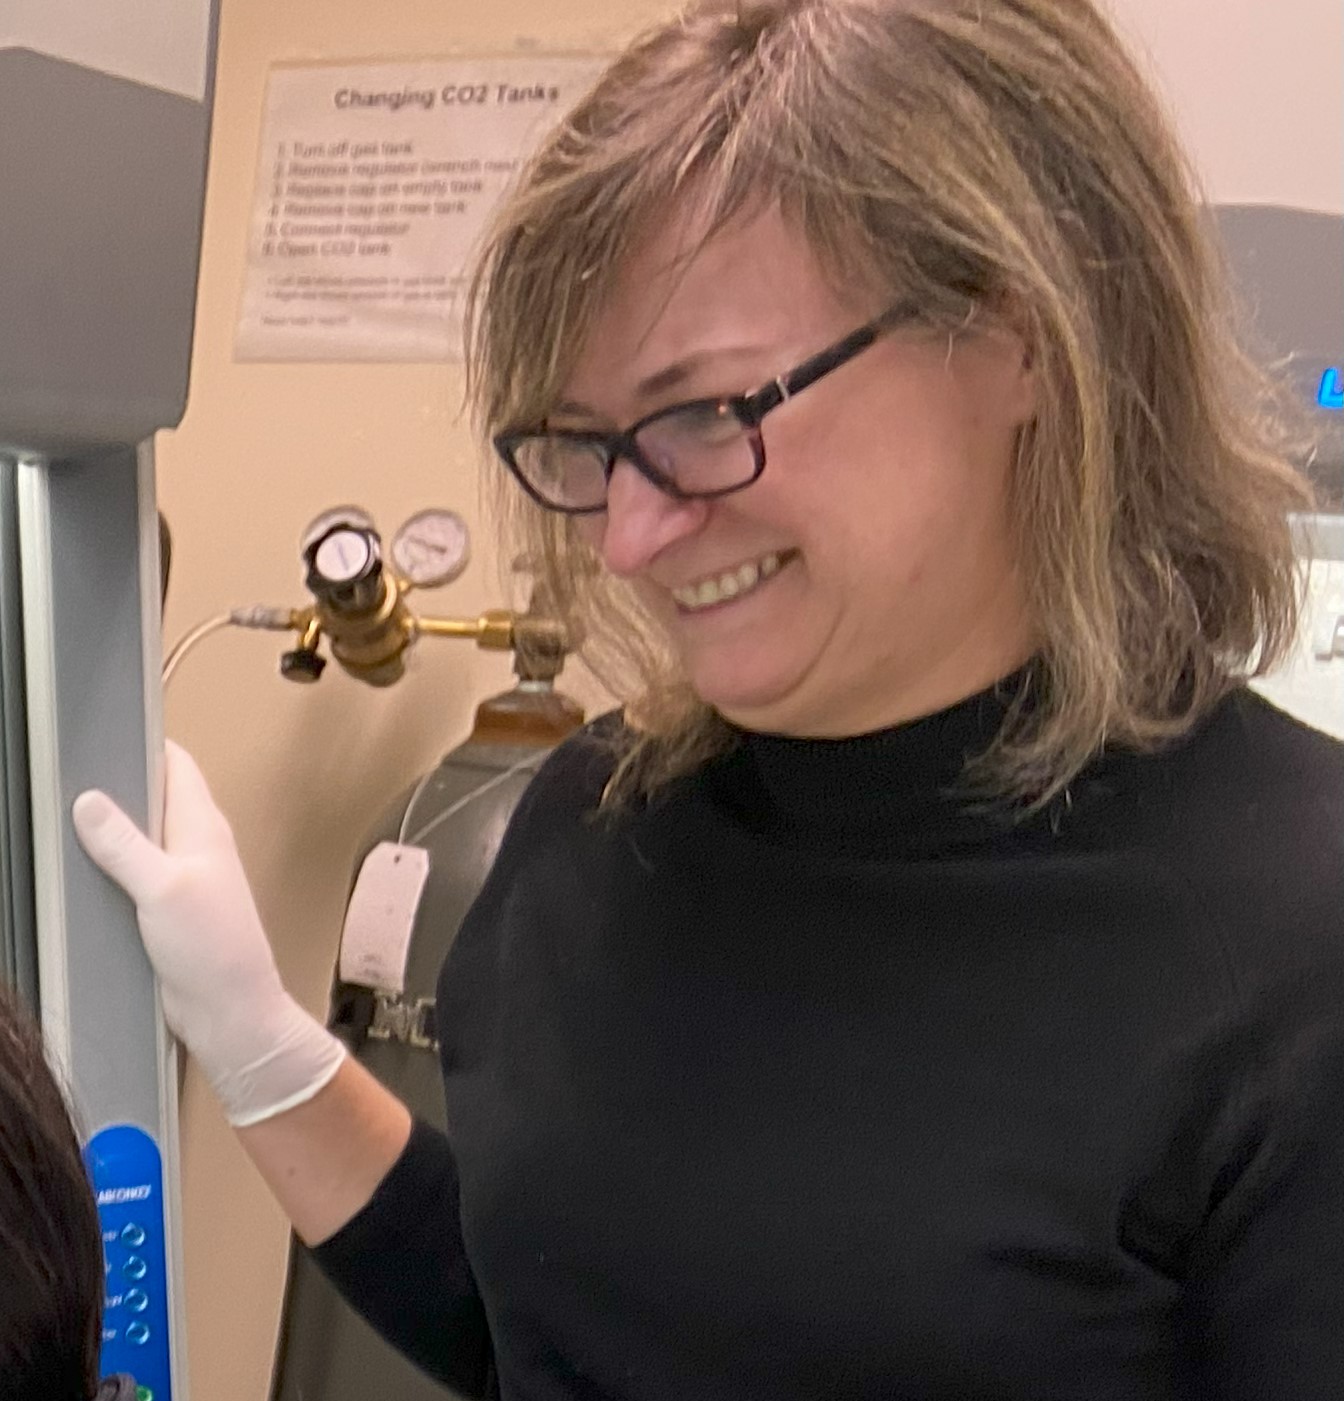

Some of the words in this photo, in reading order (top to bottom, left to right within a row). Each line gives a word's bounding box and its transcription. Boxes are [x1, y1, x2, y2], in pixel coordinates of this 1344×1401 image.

[334, 88, 434, 110] Changing
[441, 84, 487, 105] CO2
[497, 84, 558, 104] Tanks
